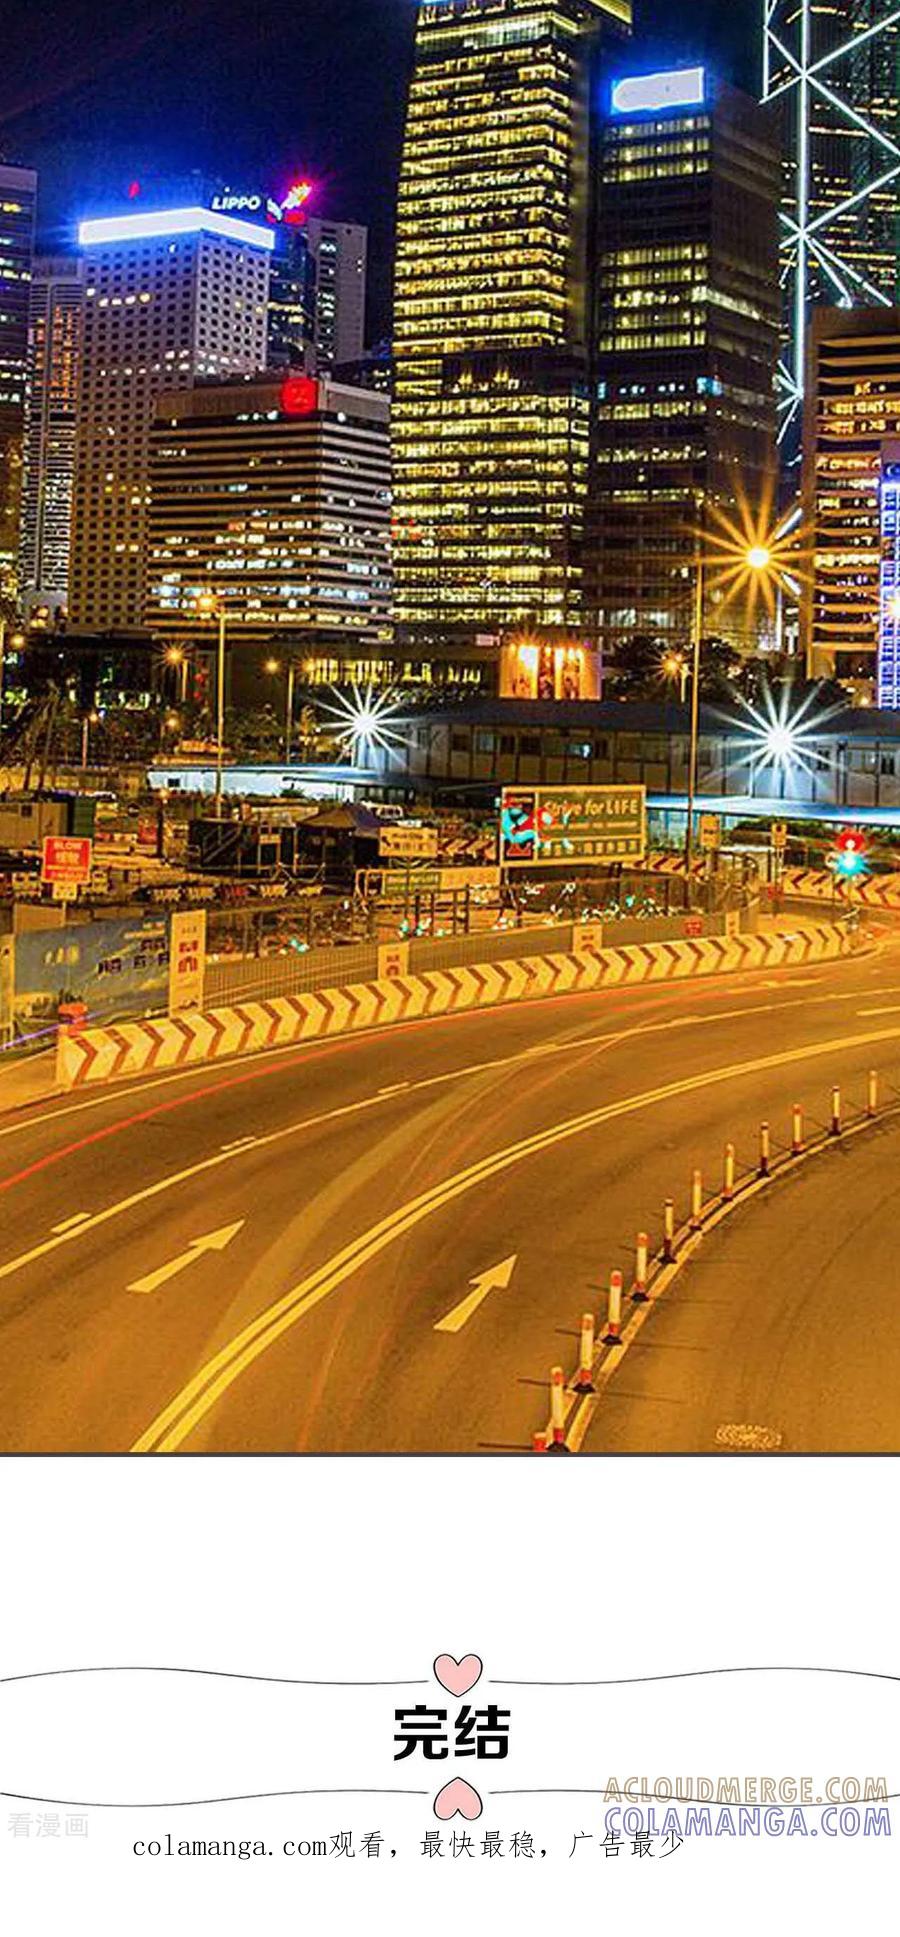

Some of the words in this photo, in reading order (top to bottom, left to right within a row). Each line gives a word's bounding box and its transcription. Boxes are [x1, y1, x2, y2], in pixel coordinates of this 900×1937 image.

[211, 195, 261, 211] LIPPO
[584, 799, 604, 816] for
[606, 799, 639, 815] LIFE
